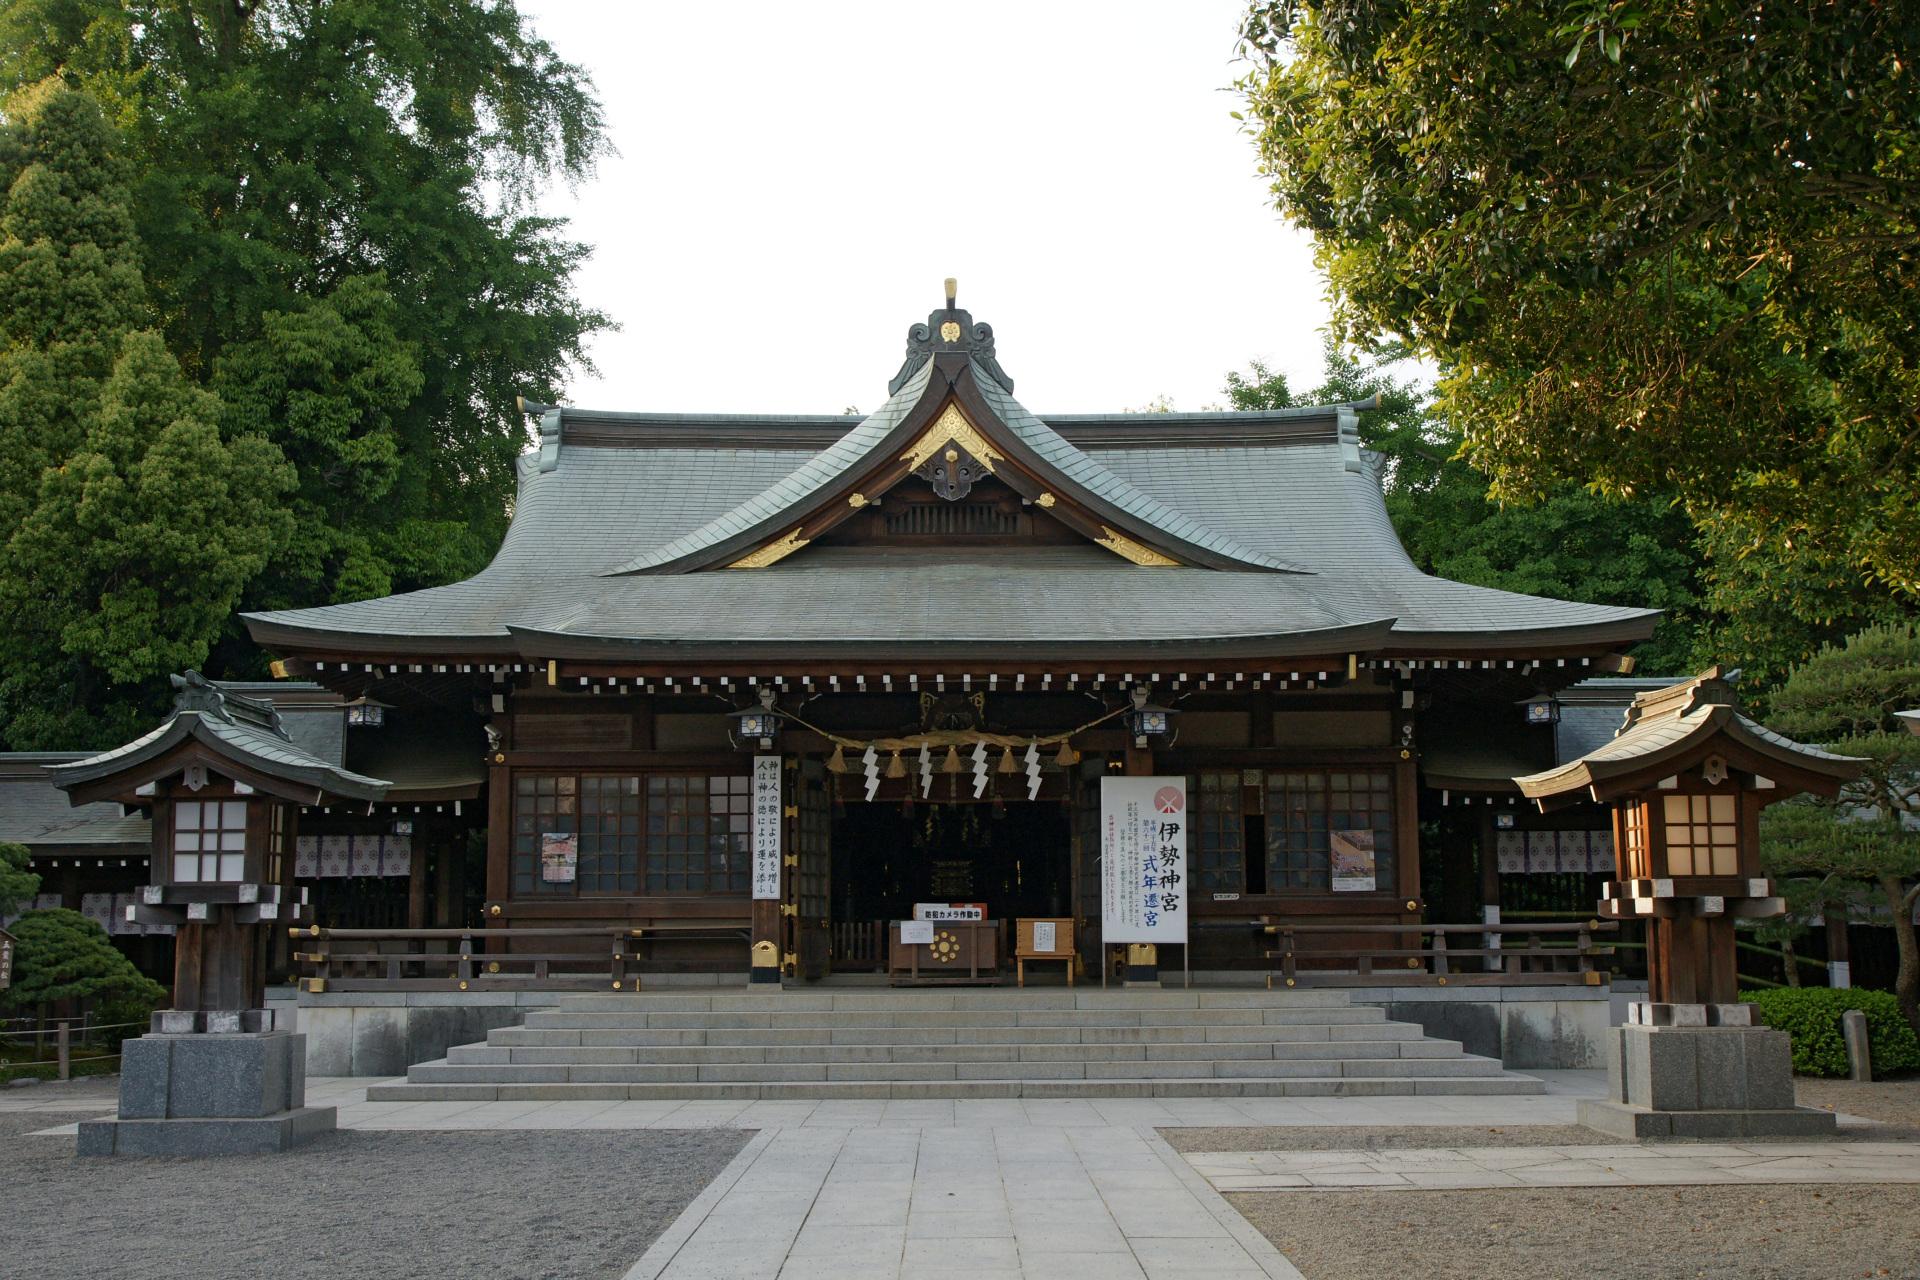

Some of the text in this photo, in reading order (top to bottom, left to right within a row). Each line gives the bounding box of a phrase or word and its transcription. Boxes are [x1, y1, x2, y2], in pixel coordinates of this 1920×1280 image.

[768, 760, 779, 894] 神は人の敬により威を増し
[1159, 821, 1181, 912] 伊勢神宮
[925, 910, 980, 919] 防犯カメラ作動中
[1142, 854, 1160, 927] 式年遷宮
